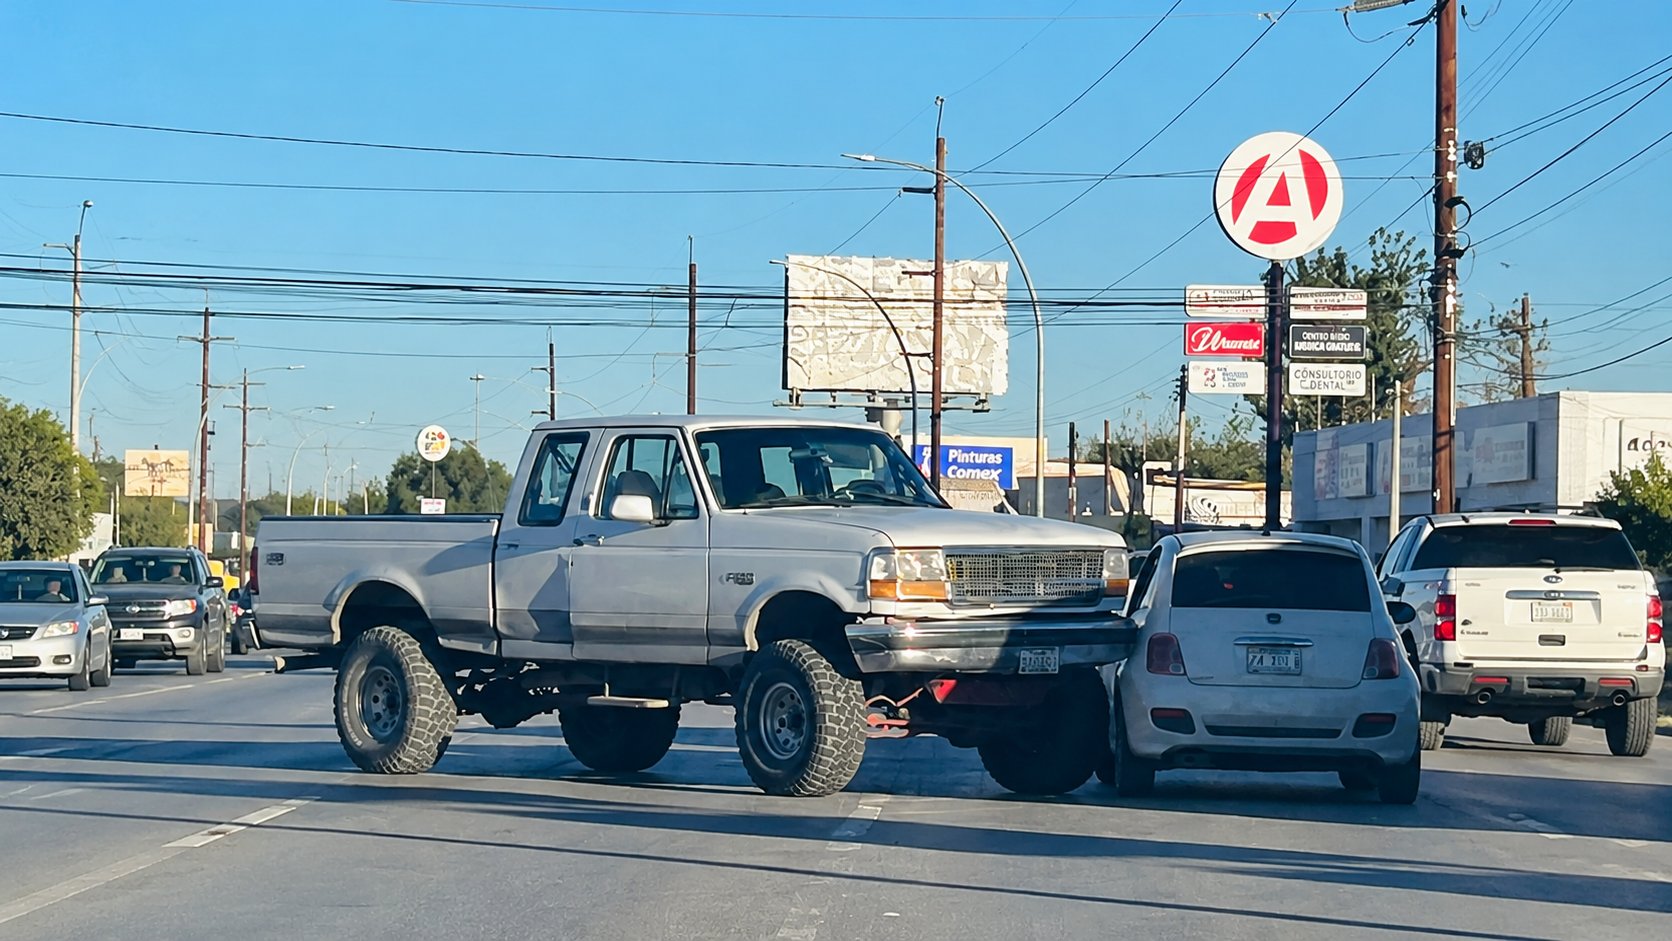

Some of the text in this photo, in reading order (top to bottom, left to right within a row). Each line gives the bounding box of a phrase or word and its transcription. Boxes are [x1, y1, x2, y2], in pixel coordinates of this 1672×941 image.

[1310, 380, 1346, 391] DENTAL
[948, 449, 1003, 464] Pinturas
[947, 465, 1002, 481] Comex
